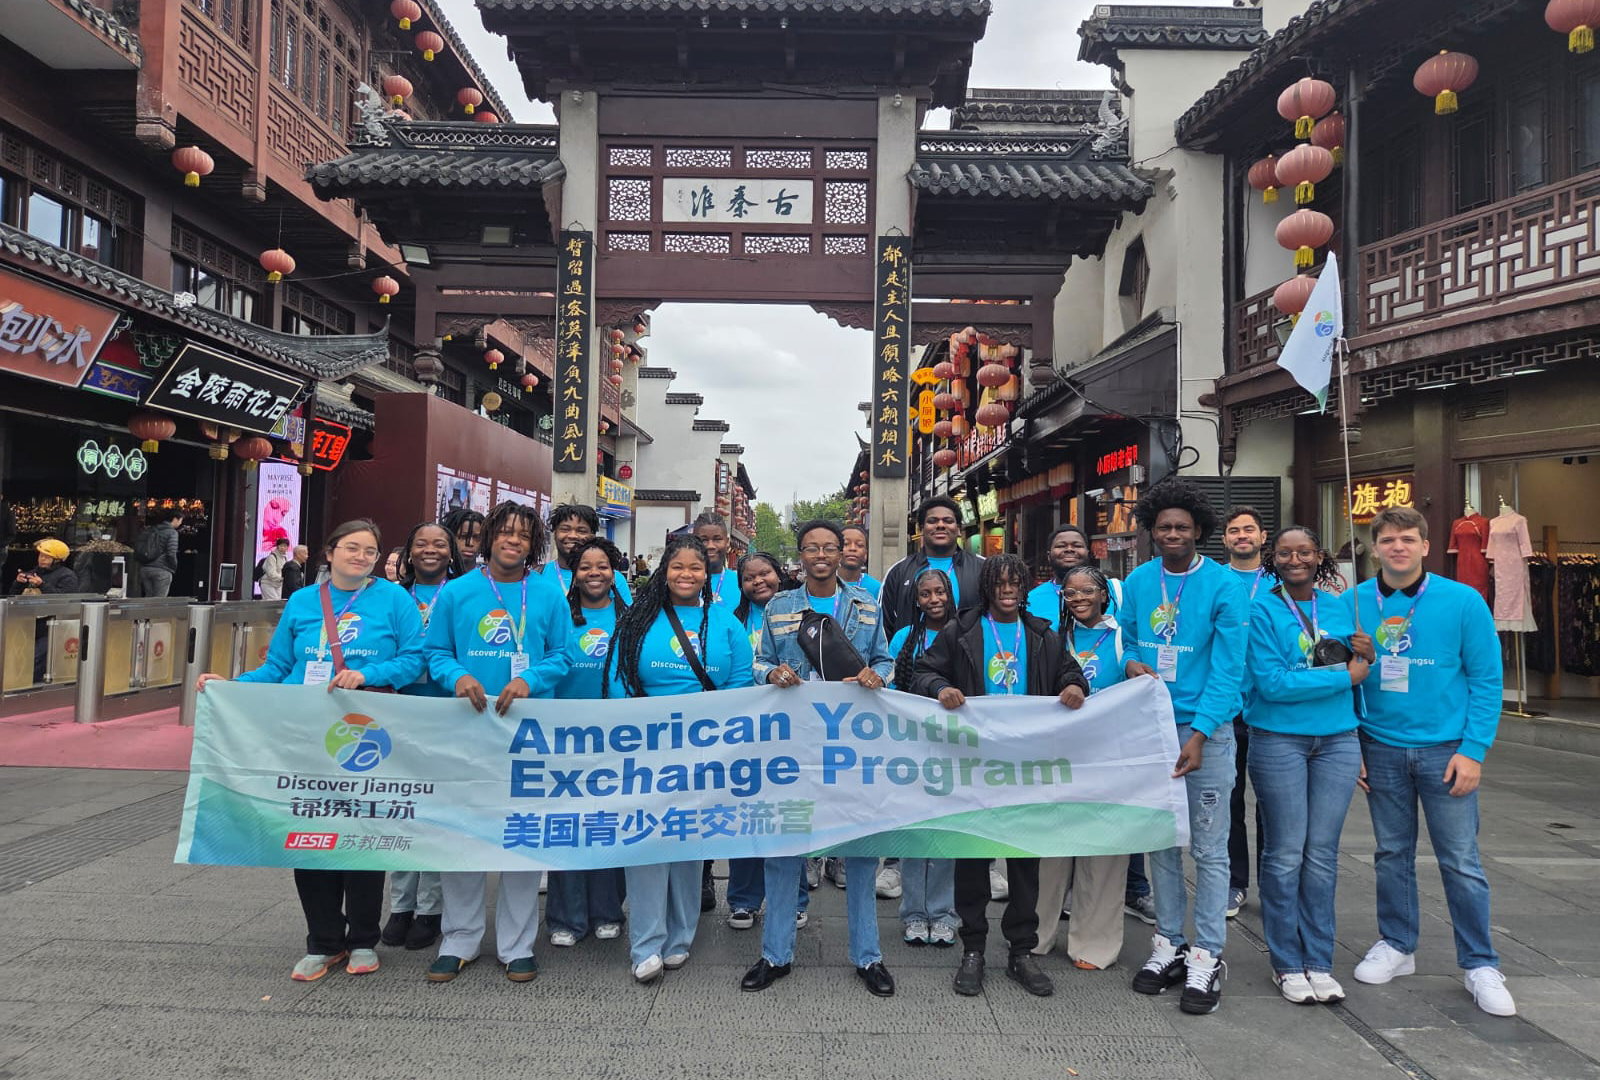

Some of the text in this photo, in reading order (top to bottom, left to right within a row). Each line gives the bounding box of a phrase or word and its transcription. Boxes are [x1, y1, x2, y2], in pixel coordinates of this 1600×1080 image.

[691, 185, 799, 218] 古秦淮
[170, 367, 292, 421] 金陵雨花石
[1351, 479, 1414, 515] 旗袍
[508, 702, 979, 755] American Youth
[276, 775, 435, 796] Discover Jiangsu
[510, 746, 1073, 798] Exchange Program
[289, 797, 418, 819] 锦绣江苏
[502, 799, 814, 849] 美国青少年交流营
[339, 834, 414, 851] 苏教国际
